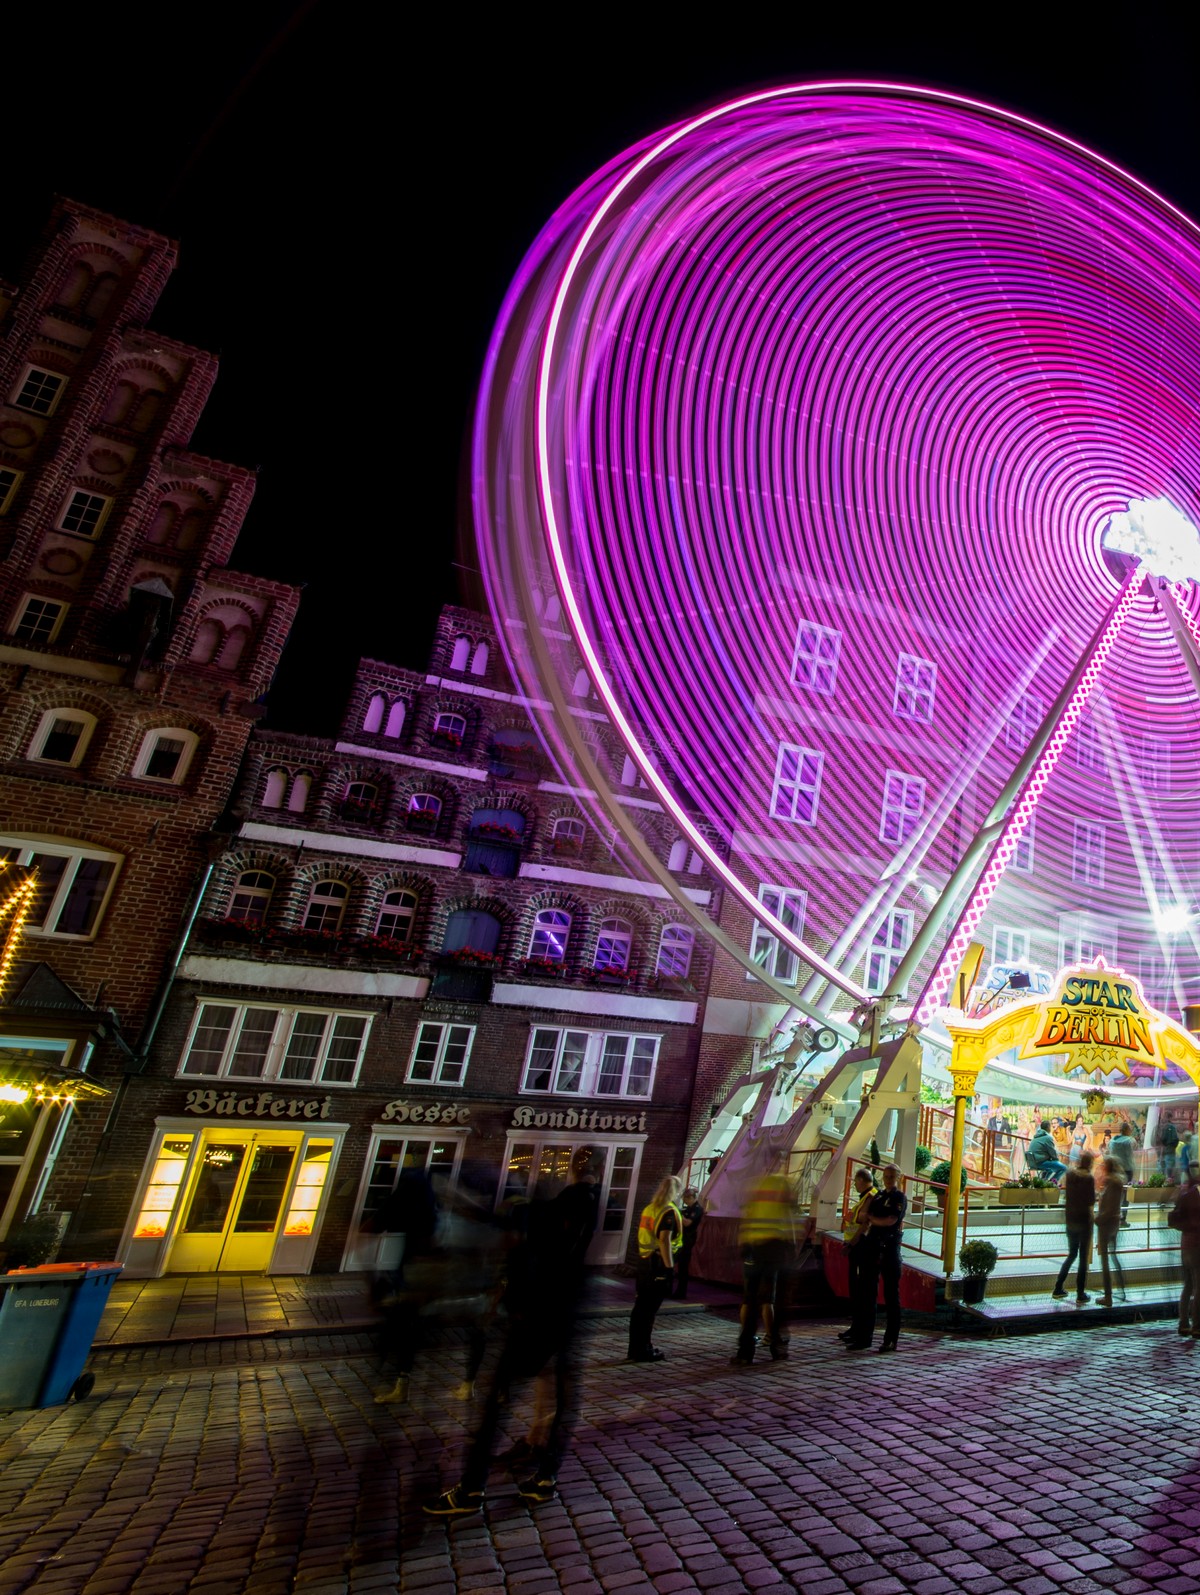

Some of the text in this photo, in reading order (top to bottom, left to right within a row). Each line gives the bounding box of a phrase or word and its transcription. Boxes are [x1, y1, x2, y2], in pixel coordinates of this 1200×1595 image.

[1061, 976, 1140, 1014] STAR
[1091, 1007, 1106, 1018] OF
[1034, 1007, 1155, 1057] BERLIN
[184, 1089, 647, 1132] Bäckerei Hesse Konditorei
